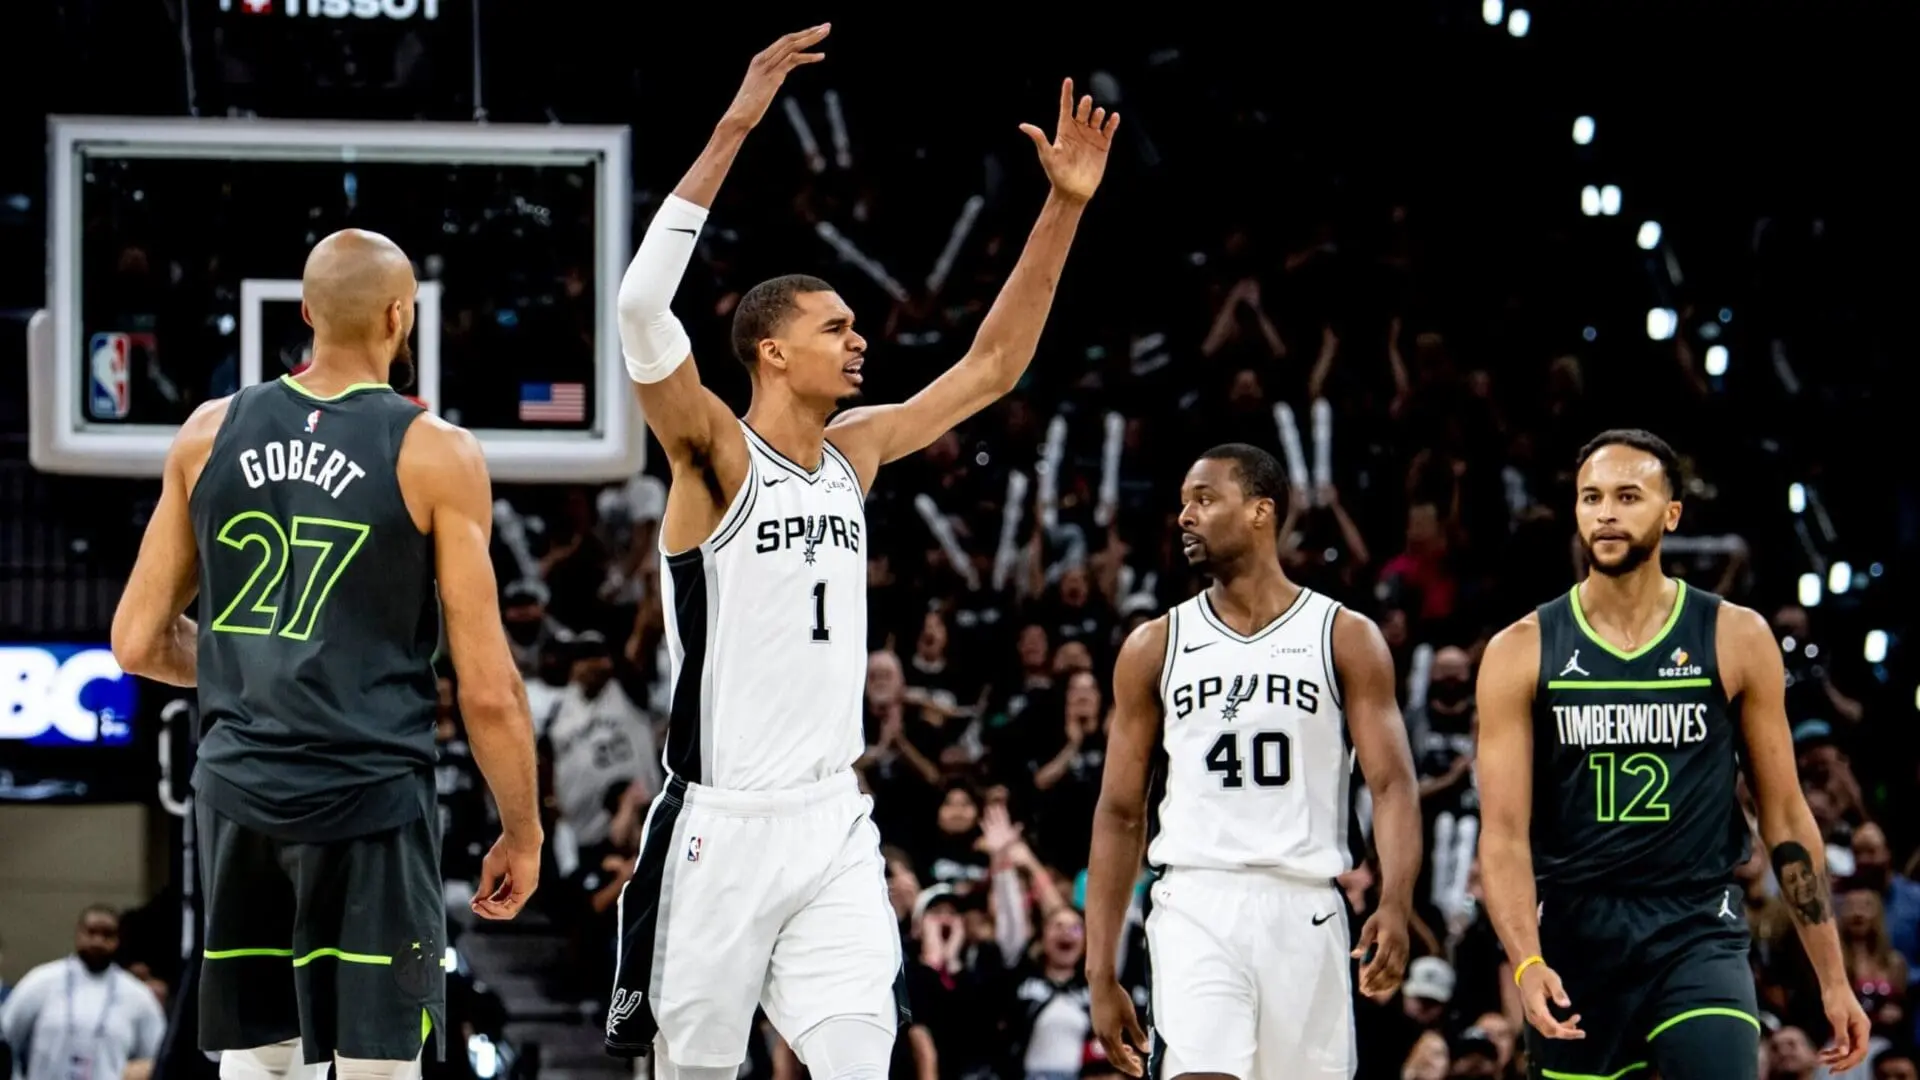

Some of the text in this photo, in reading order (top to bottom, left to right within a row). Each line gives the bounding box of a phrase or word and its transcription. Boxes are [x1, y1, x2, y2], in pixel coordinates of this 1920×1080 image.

[239, 439, 366, 499] GOBERT
[756, 514, 860, 566] SPURS
[211, 510, 370, 641] 27
[810, 579, 832, 644] 1
[1173, 674, 1320, 722] SPURS
[1658, 664, 1702, 677] sezzle
[1552, 703, 1708, 750] TIMBERWOLVES
[1203, 729, 1294, 790] 40
[1589, 752, 1670, 822] 12
